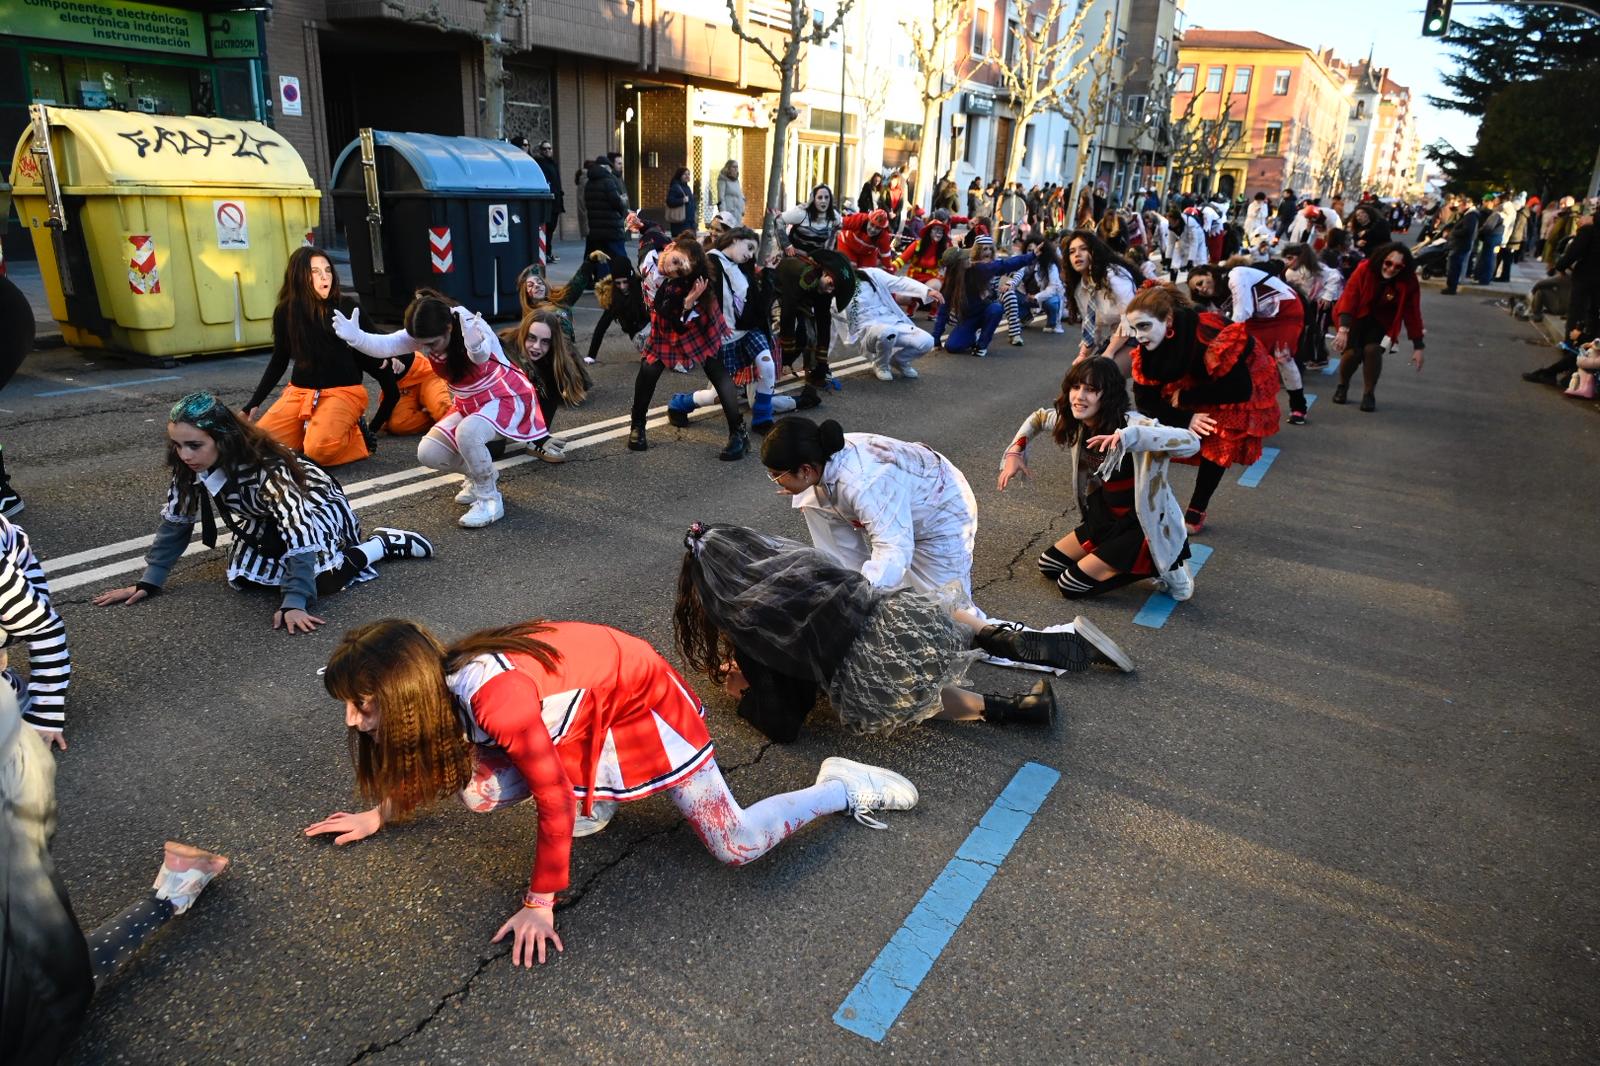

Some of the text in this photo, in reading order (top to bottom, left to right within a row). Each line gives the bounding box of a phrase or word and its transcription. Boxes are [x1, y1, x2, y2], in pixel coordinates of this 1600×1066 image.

[60, 12, 189, 37] electrónica industrial
[116, 8, 188, 26] electrónicos
[93, 27, 191, 48] instrumentación
[214, 39, 255, 49] ELECTROSON
